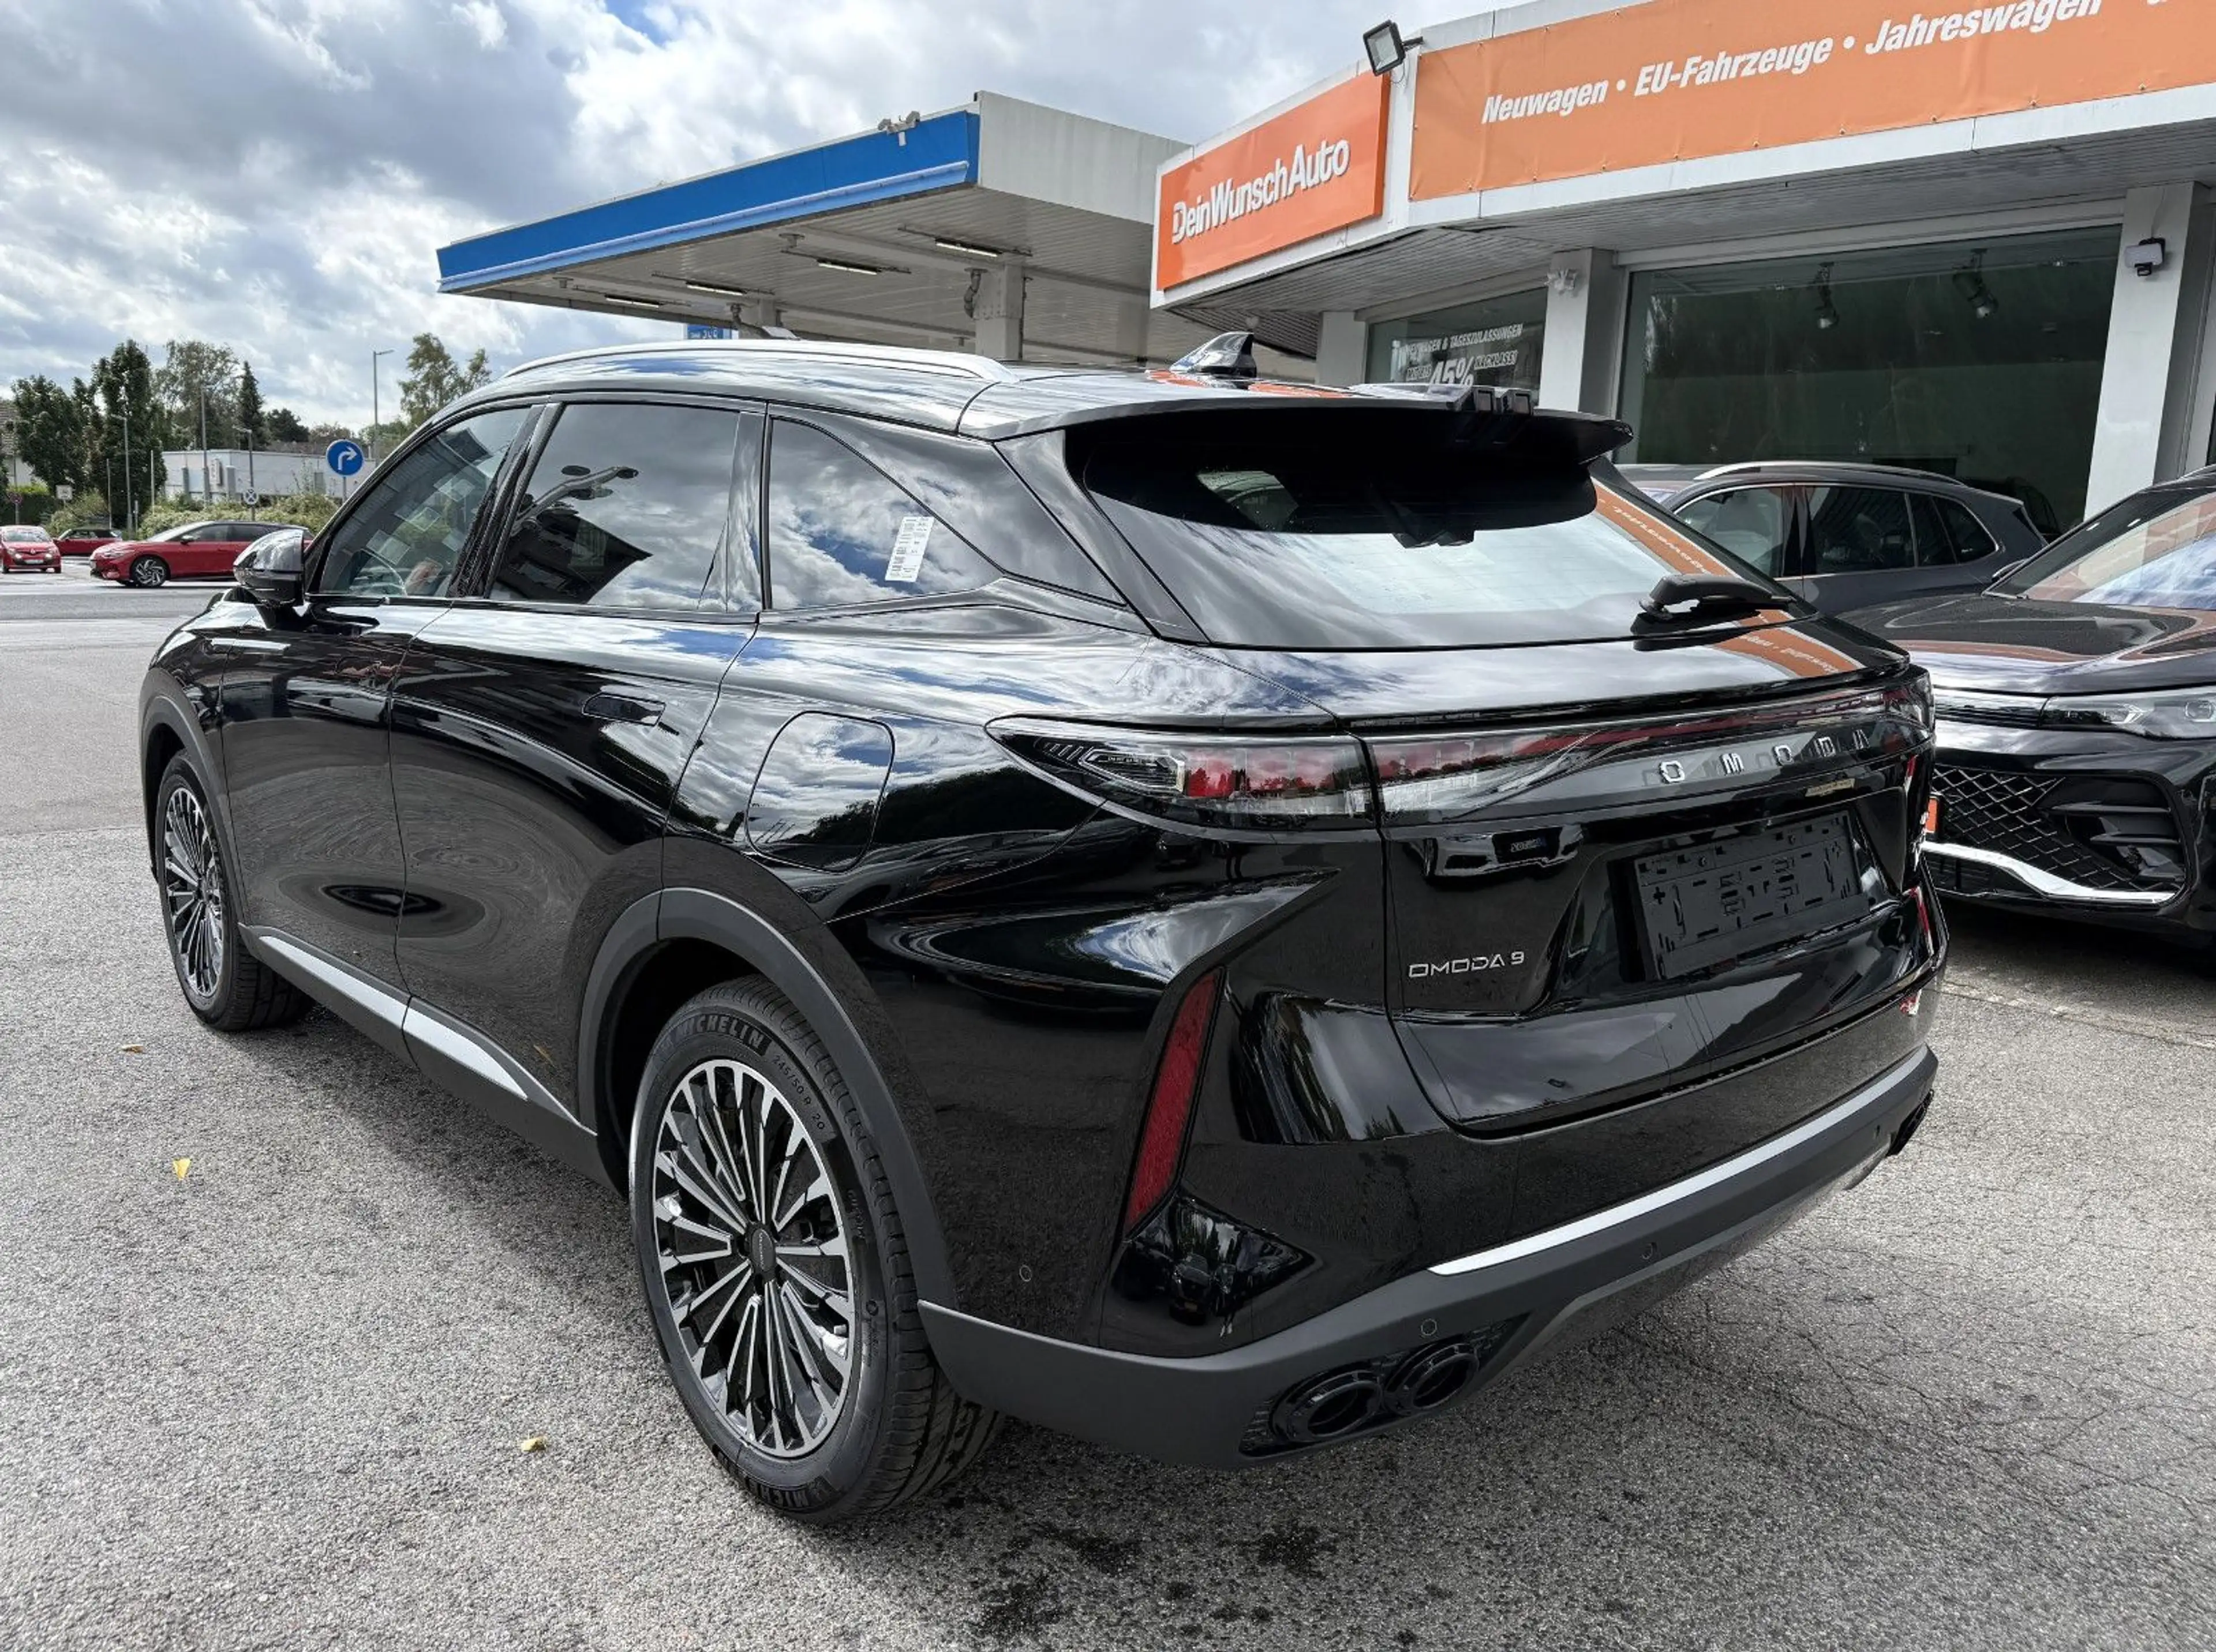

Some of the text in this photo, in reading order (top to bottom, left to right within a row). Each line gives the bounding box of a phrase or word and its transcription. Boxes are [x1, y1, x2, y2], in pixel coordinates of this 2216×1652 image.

[1481, 0, 2102, 124] Neuwagen EU-Fahrzeuge Jahreswagen
[1450, 323, 1523, 349] TAGESZULASSUNGEN
[1409, 952, 1525, 977] OMODA 9
[676, 1014, 765, 1049] MICHELIN
[773, 1054, 804, 1095] 245/50
[811, 1112, 825, 1130] 20
